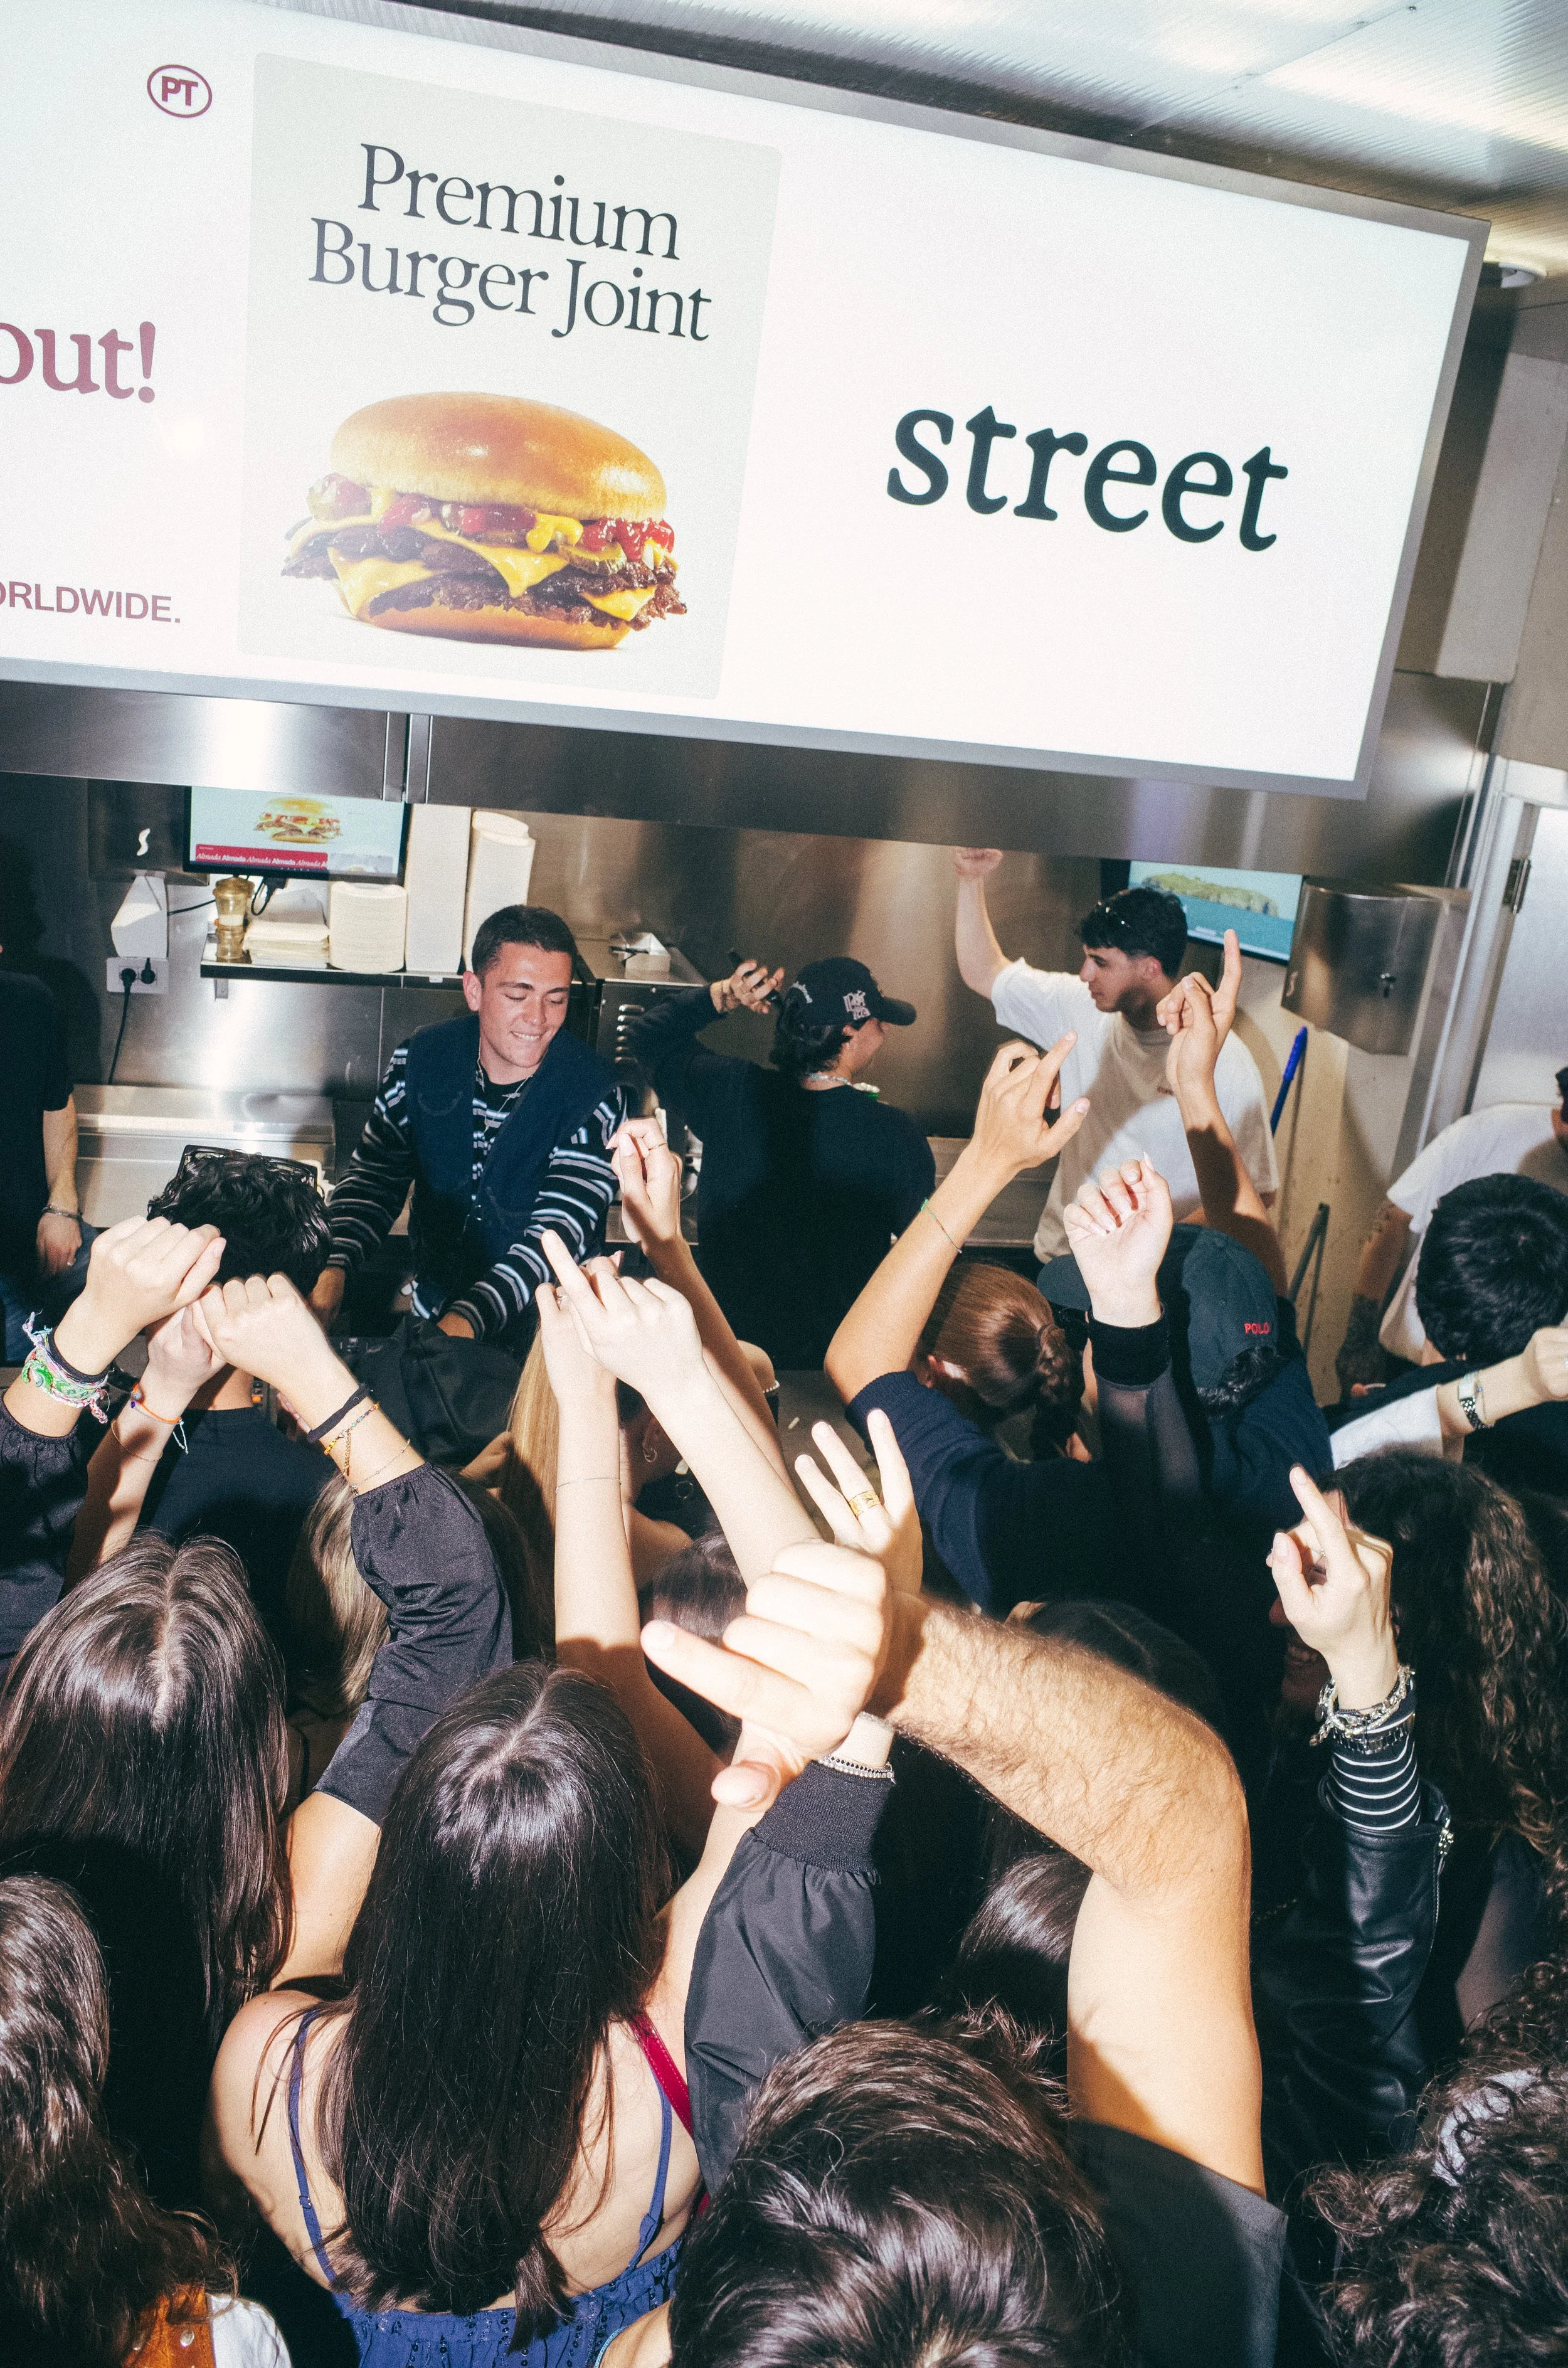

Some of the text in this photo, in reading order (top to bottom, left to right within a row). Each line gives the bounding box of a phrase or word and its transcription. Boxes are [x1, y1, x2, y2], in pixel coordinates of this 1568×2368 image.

[161, 75, 199, 107] PT
[358, 142, 680, 261] Premium
[307, 216, 712, 342] Burger Joint
[887, 405, 1289, 552] street
[0, 580, 181, 624] RLDWIDE.
[1244, 1321, 1270, 1334] POLO
